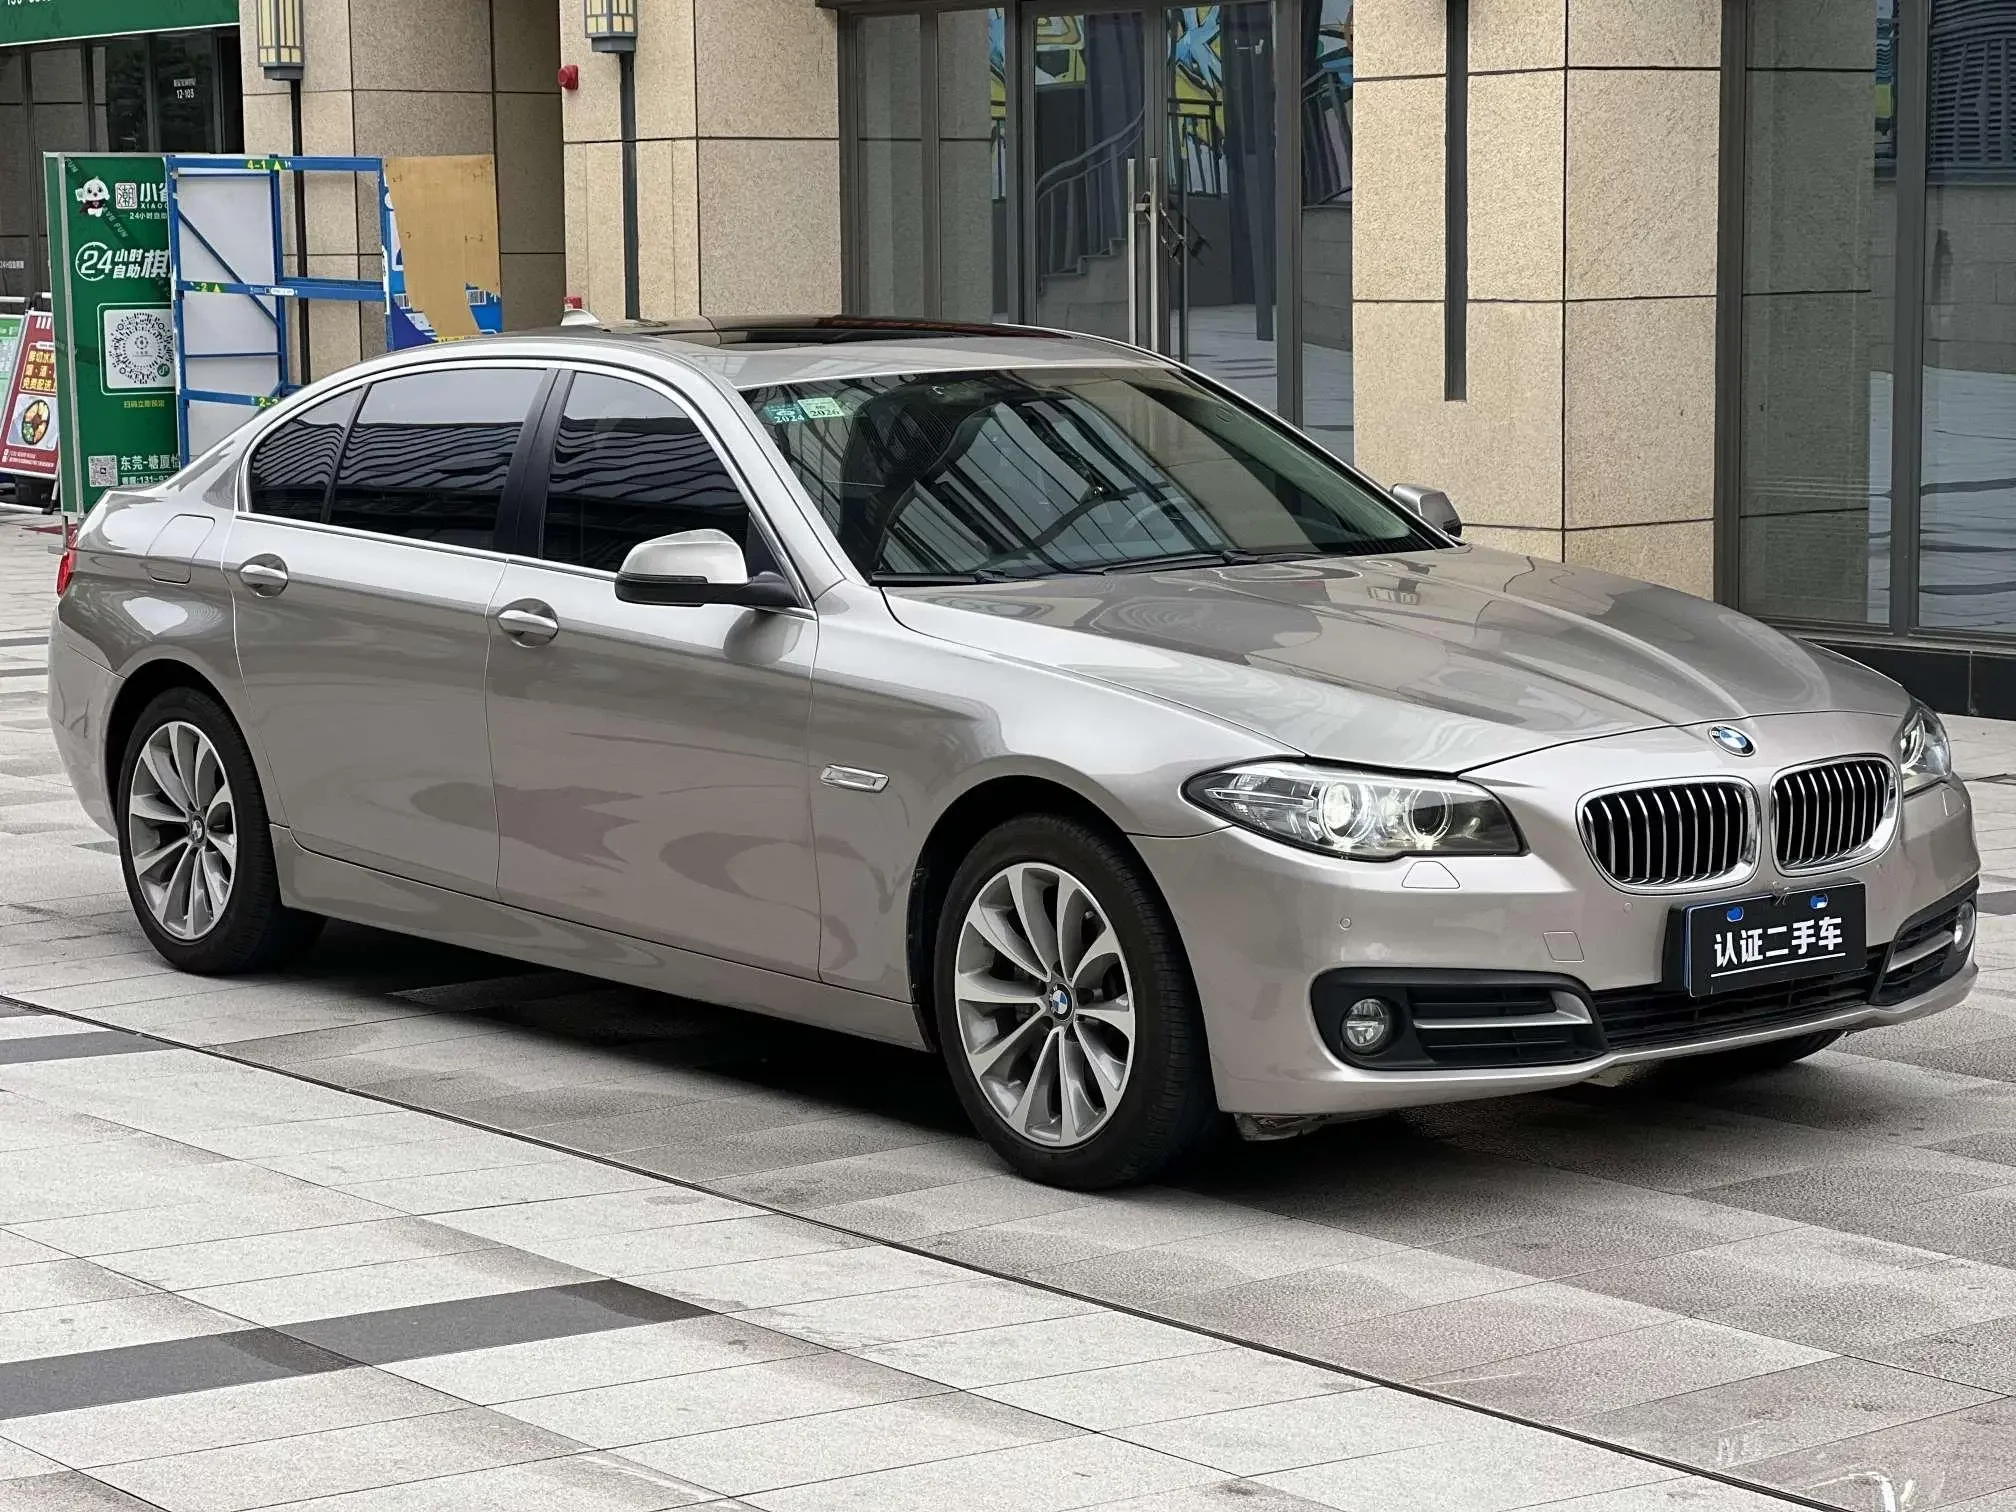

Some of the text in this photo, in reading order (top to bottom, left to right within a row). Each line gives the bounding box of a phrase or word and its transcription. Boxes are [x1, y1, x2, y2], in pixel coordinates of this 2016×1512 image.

[247, 160, 266, 170] 4-1
[80, 248, 173, 278] 24 小时 棋
[112, 263, 141, 279] 自助
[810, 409, 840, 417] 2026
[1714, 916, 1843, 967] 认证二手车
